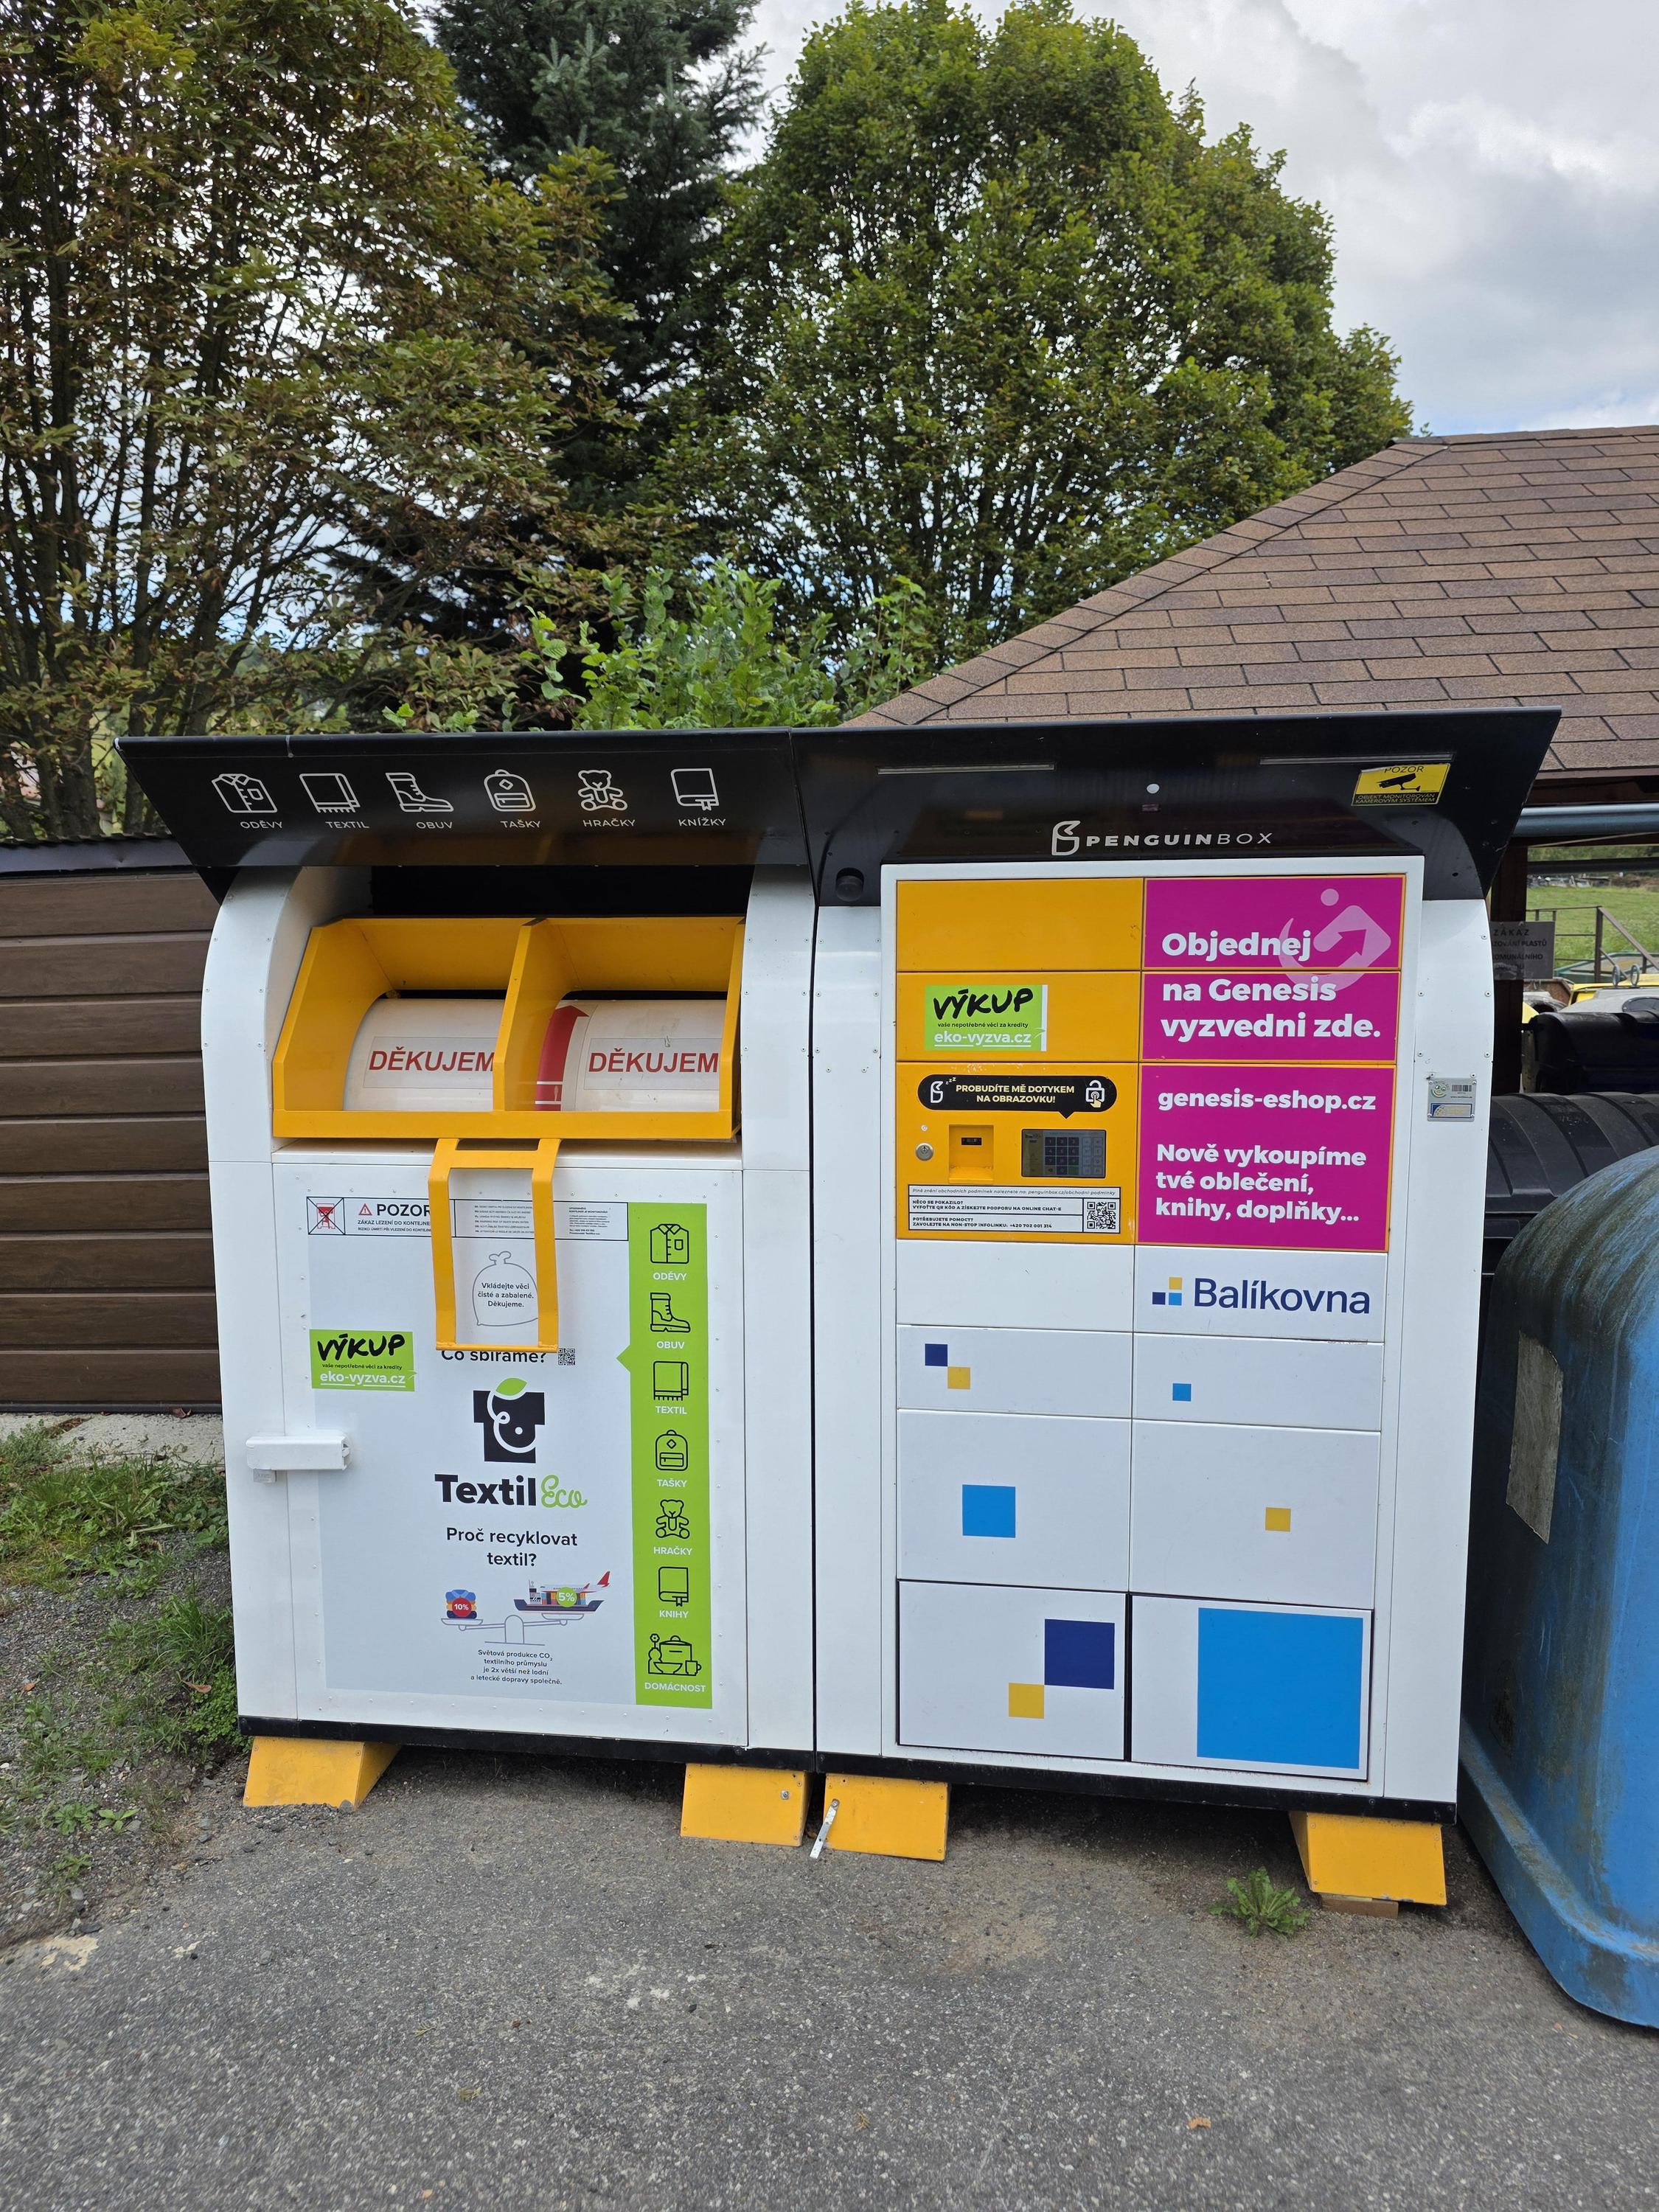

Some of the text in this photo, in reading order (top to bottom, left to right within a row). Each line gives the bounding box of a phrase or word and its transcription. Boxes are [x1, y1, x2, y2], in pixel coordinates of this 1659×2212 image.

[240, 818, 282, 829] ODĚVY
[325, 821, 369, 829] TEXTIL
[416, 821, 453, 829] OBUV
[501, 818, 541, 829] TAŠKY
[582, 817, 636, 828] HRAČKY
[678, 815, 727, 827] KNÍŽKY
[1086, 831, 1273, 847] PENGUINBOX
[1161, 930, 1311, 962] Objednej
[1163, 975, 1337, 1003] na Genesis
[933, 988, 1033, 1020] VÝKUP
[1161, 1012, 1381, 1042] vyzvedni zde.
[934, 1031, 1032, 1045] eko-vyzva.cz
[956, 1084, 1009, 1093] PROBUDÍTE
[1012, 1083, 1026, 1093] MĚ
[992, 1095, 1055, 1103] OBRAZOVKU!
[1158, 1088, 1376, 1113] genesis-eshop.cz
[1157, 1143, 1366, 1169] Nově vykoupíme
[1155, 1171, 1313, 1195] tvé oblečení,
[1155, 1198, 1231, 1221] knihy,
[653, 1271, 686, 1281] ODĚVY
[481, 1282, 514, 1290] Vkládejte
[1194, 1279, 1370, 1314] Balíkovna
[317, 1333, 405, 1361] VÝKUP
[656, 1340, 685, 1349] OBUV
[442, 1350, 465, 1360] Co
[320, 1371, 406, 1385] eko-vyzva.cz
[655, 1405, 687, 1414] TEXTIL
[657, 1478, 687, 1487] TAŠKY
[447, 1527, 577, 1547] Proč recyklovat
[653, 1545, 692, 1555] HRAČKY
[487, 1552, 537, 1567] textil?
[558, 1592, 575, 1602] 5%
[659, 1610, 689, 1618] KNIHY
[507, 1651, 538, 1659] produkce
[516, 1660, 547, 1668] průmyslu
[644, 1680, 706, 1691] DOMÁCNOST
